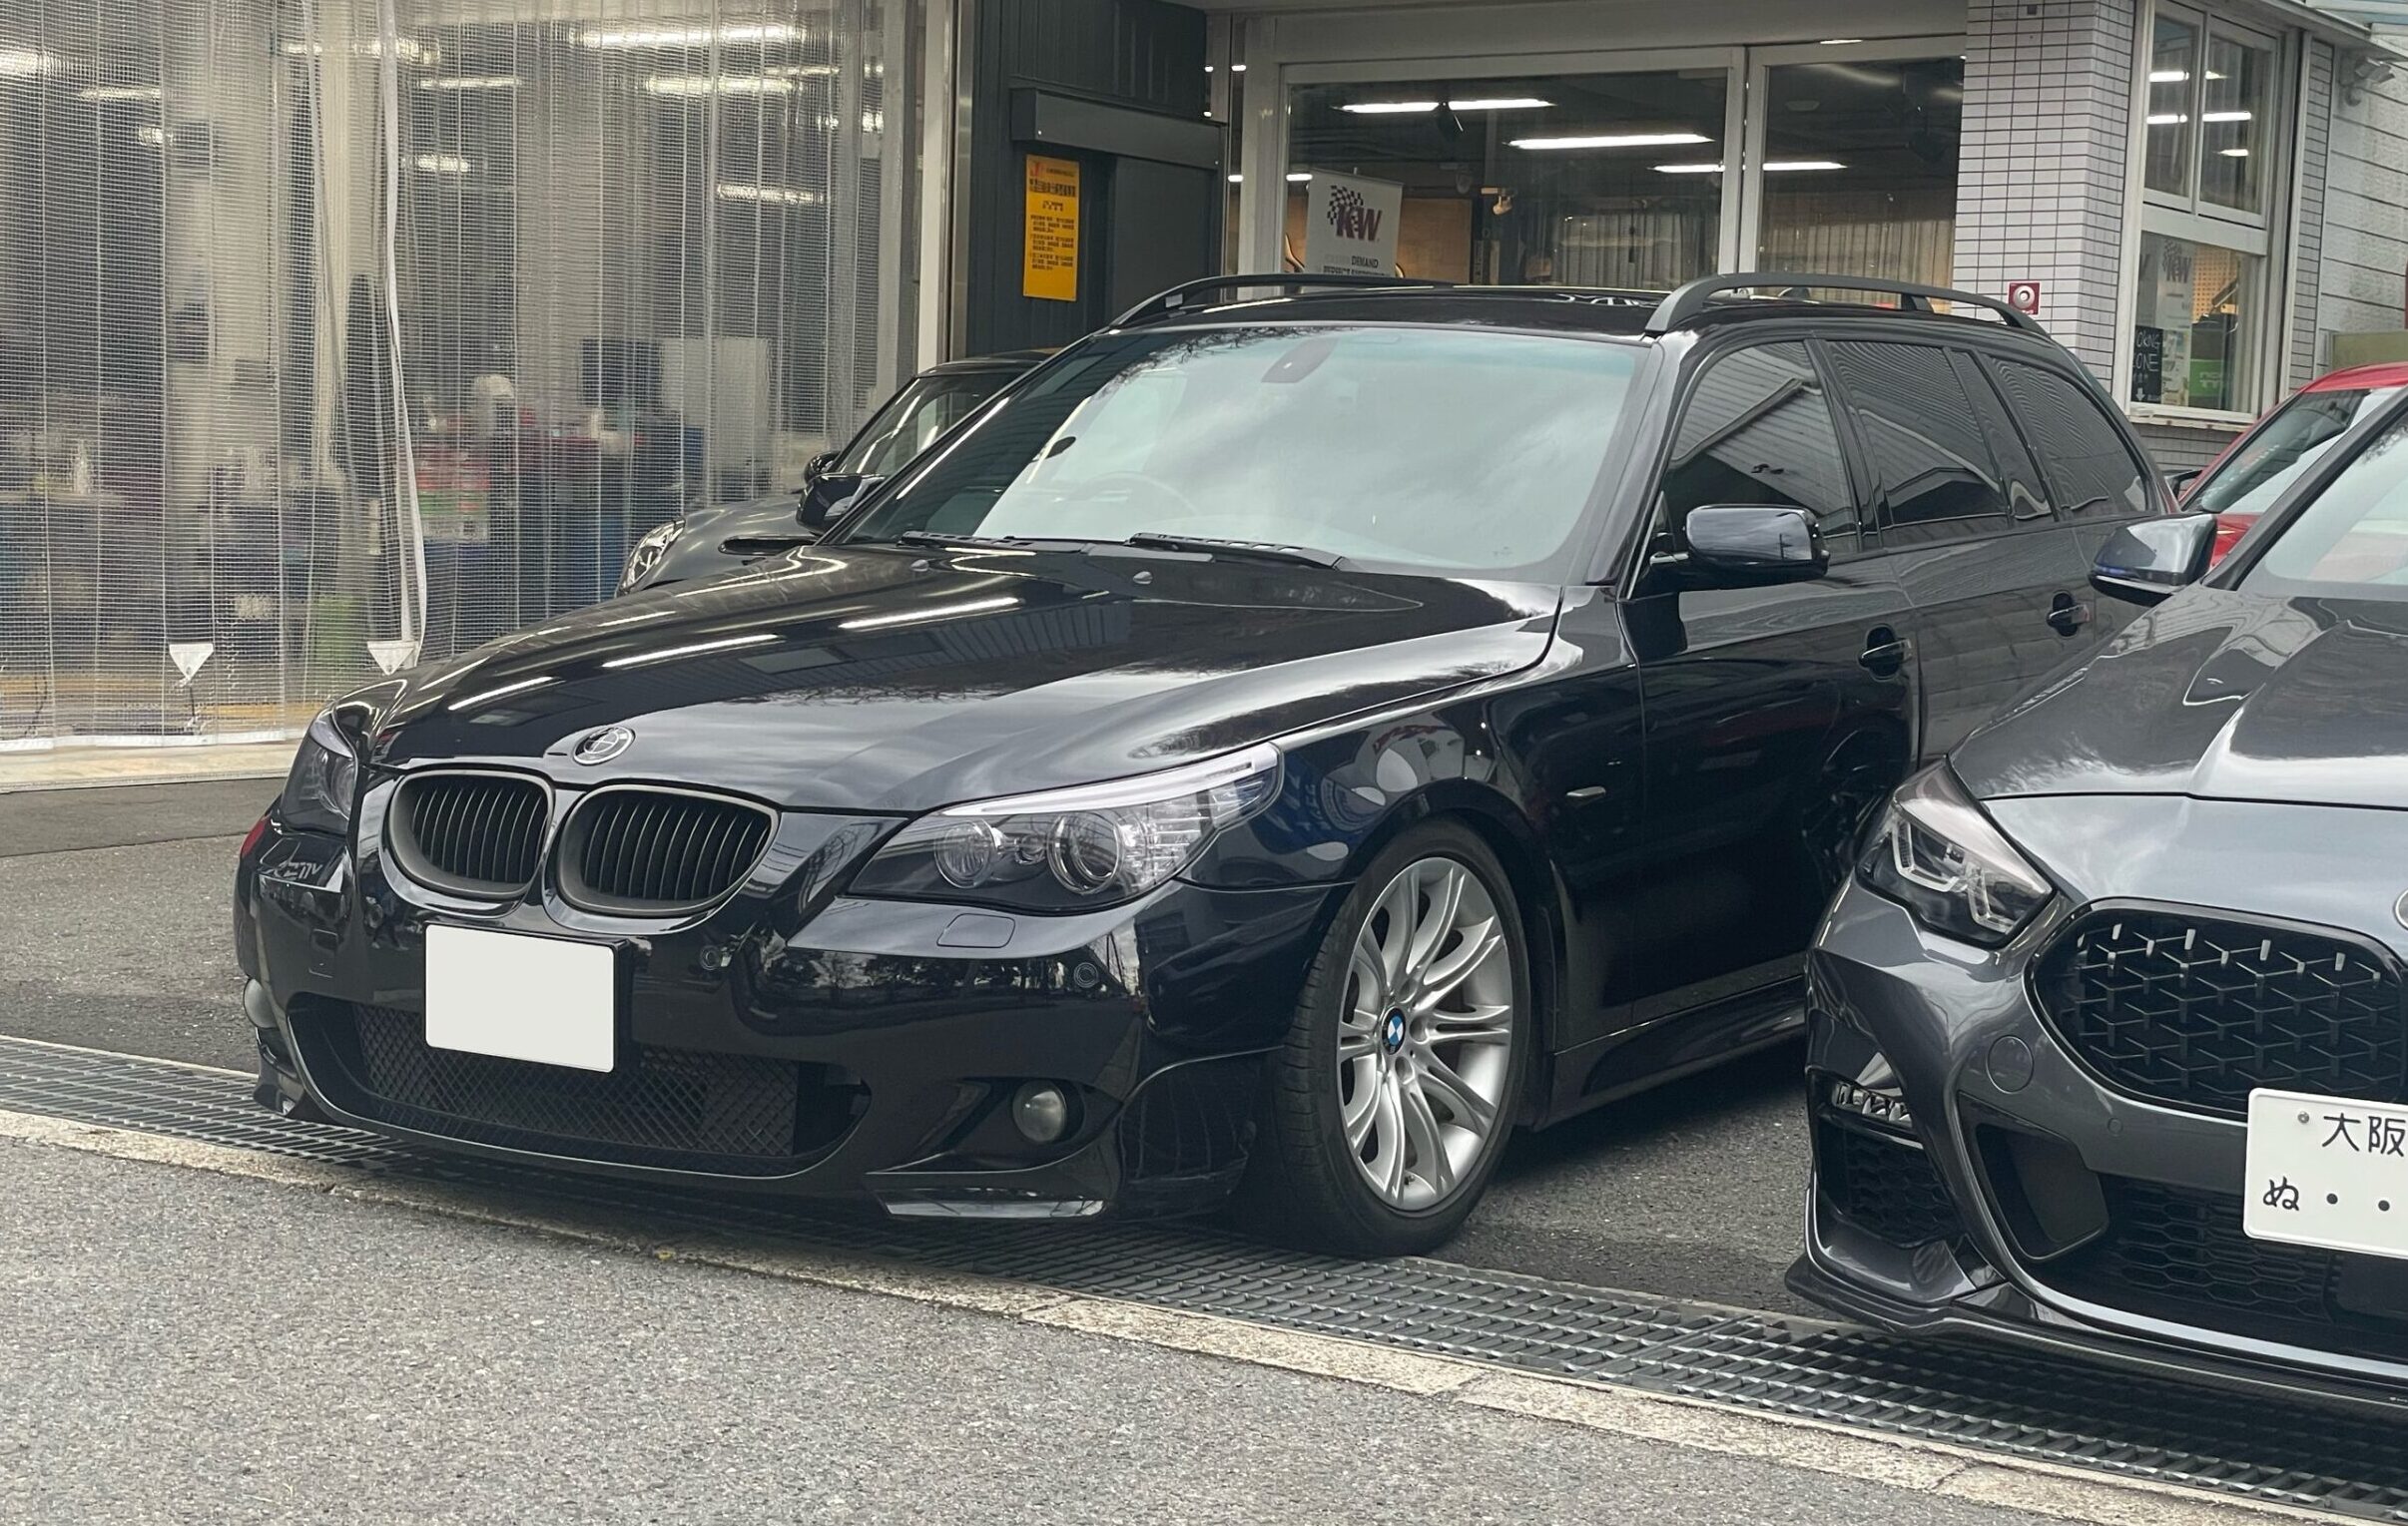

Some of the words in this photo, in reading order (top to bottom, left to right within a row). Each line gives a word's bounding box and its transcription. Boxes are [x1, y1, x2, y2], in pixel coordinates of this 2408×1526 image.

[1336, 206, 1383, 242] KW
[1351, 255, 1379, 268] DEMAND
[2132, 352, 2159, 372] ONE
[2321, 1112, 2407, 1157] 大阪
